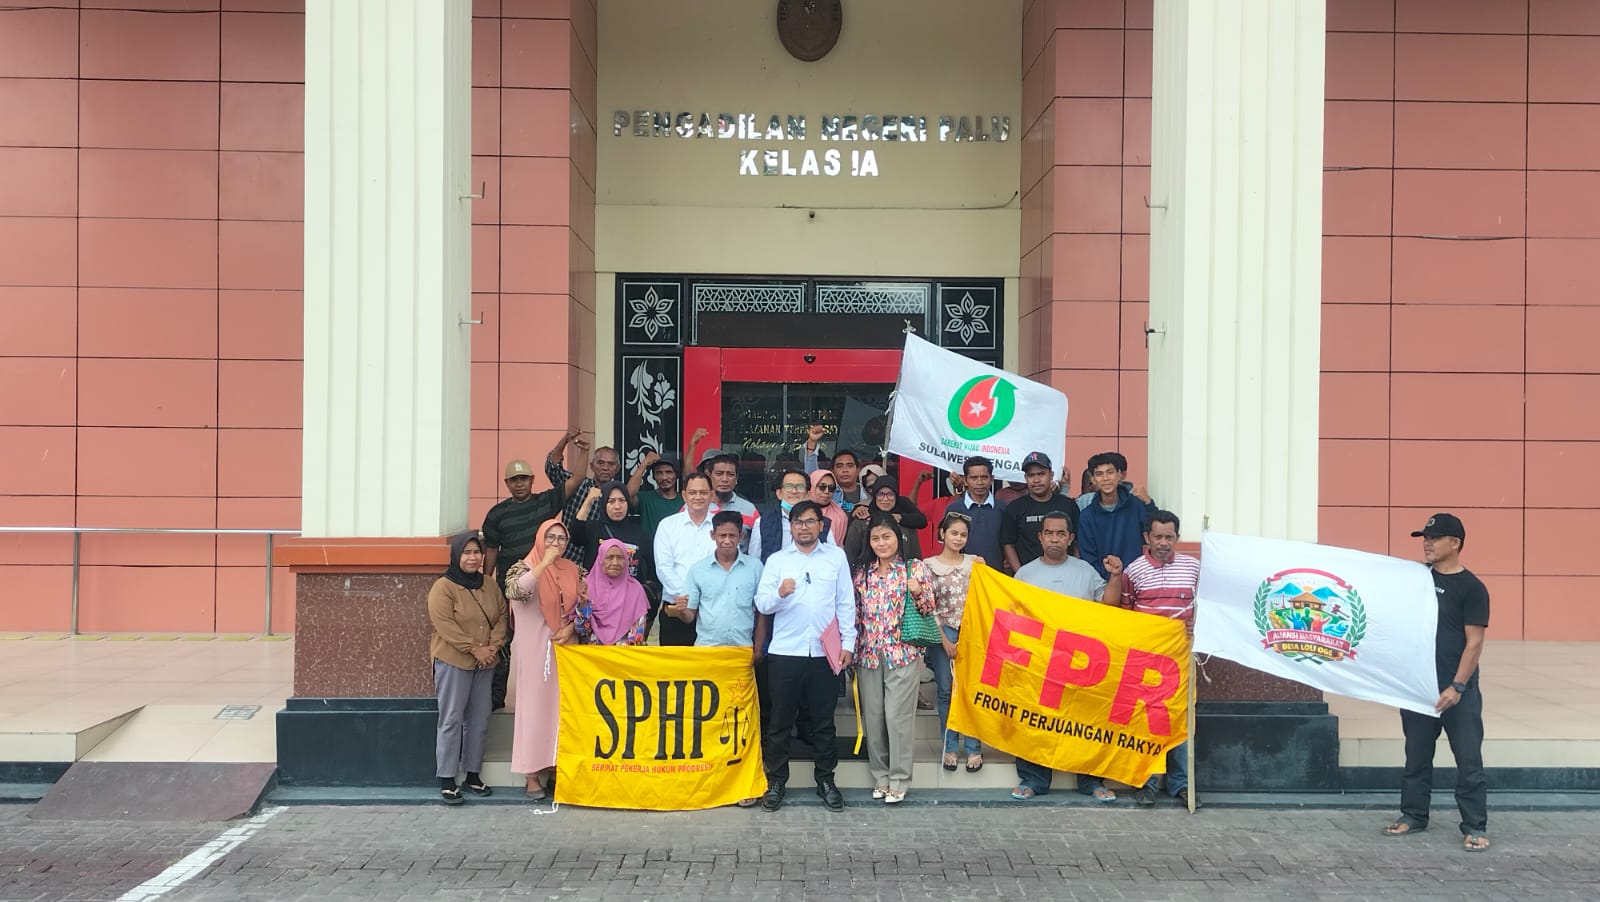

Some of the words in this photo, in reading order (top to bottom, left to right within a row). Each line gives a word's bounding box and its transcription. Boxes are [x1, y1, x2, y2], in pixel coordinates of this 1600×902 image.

[613, 111, 806, 140] PENGADILAN
[821, 113, 927, 142] NEGERI
[938, 115, 1010, 142] PALU
[739, 149, 841, 176] KELAS
[851, 149, 879, 176] IA
[918, 442, 969, 465] SULAWES
[981, 444, 1010, 455] INDONESIA
[980, 608, 1180, 736] FPR
[594, 678, 720, 760] SPHP
[974, 692, 1018, 719] FRONT
[1019, 709, 1114, 745] PERJUANGAN
[1117, 733, 1166, 756] RAKYA
[591, 763, 618, 772] SERIKAT
[620, 764, 649, 773] PEKERJA
